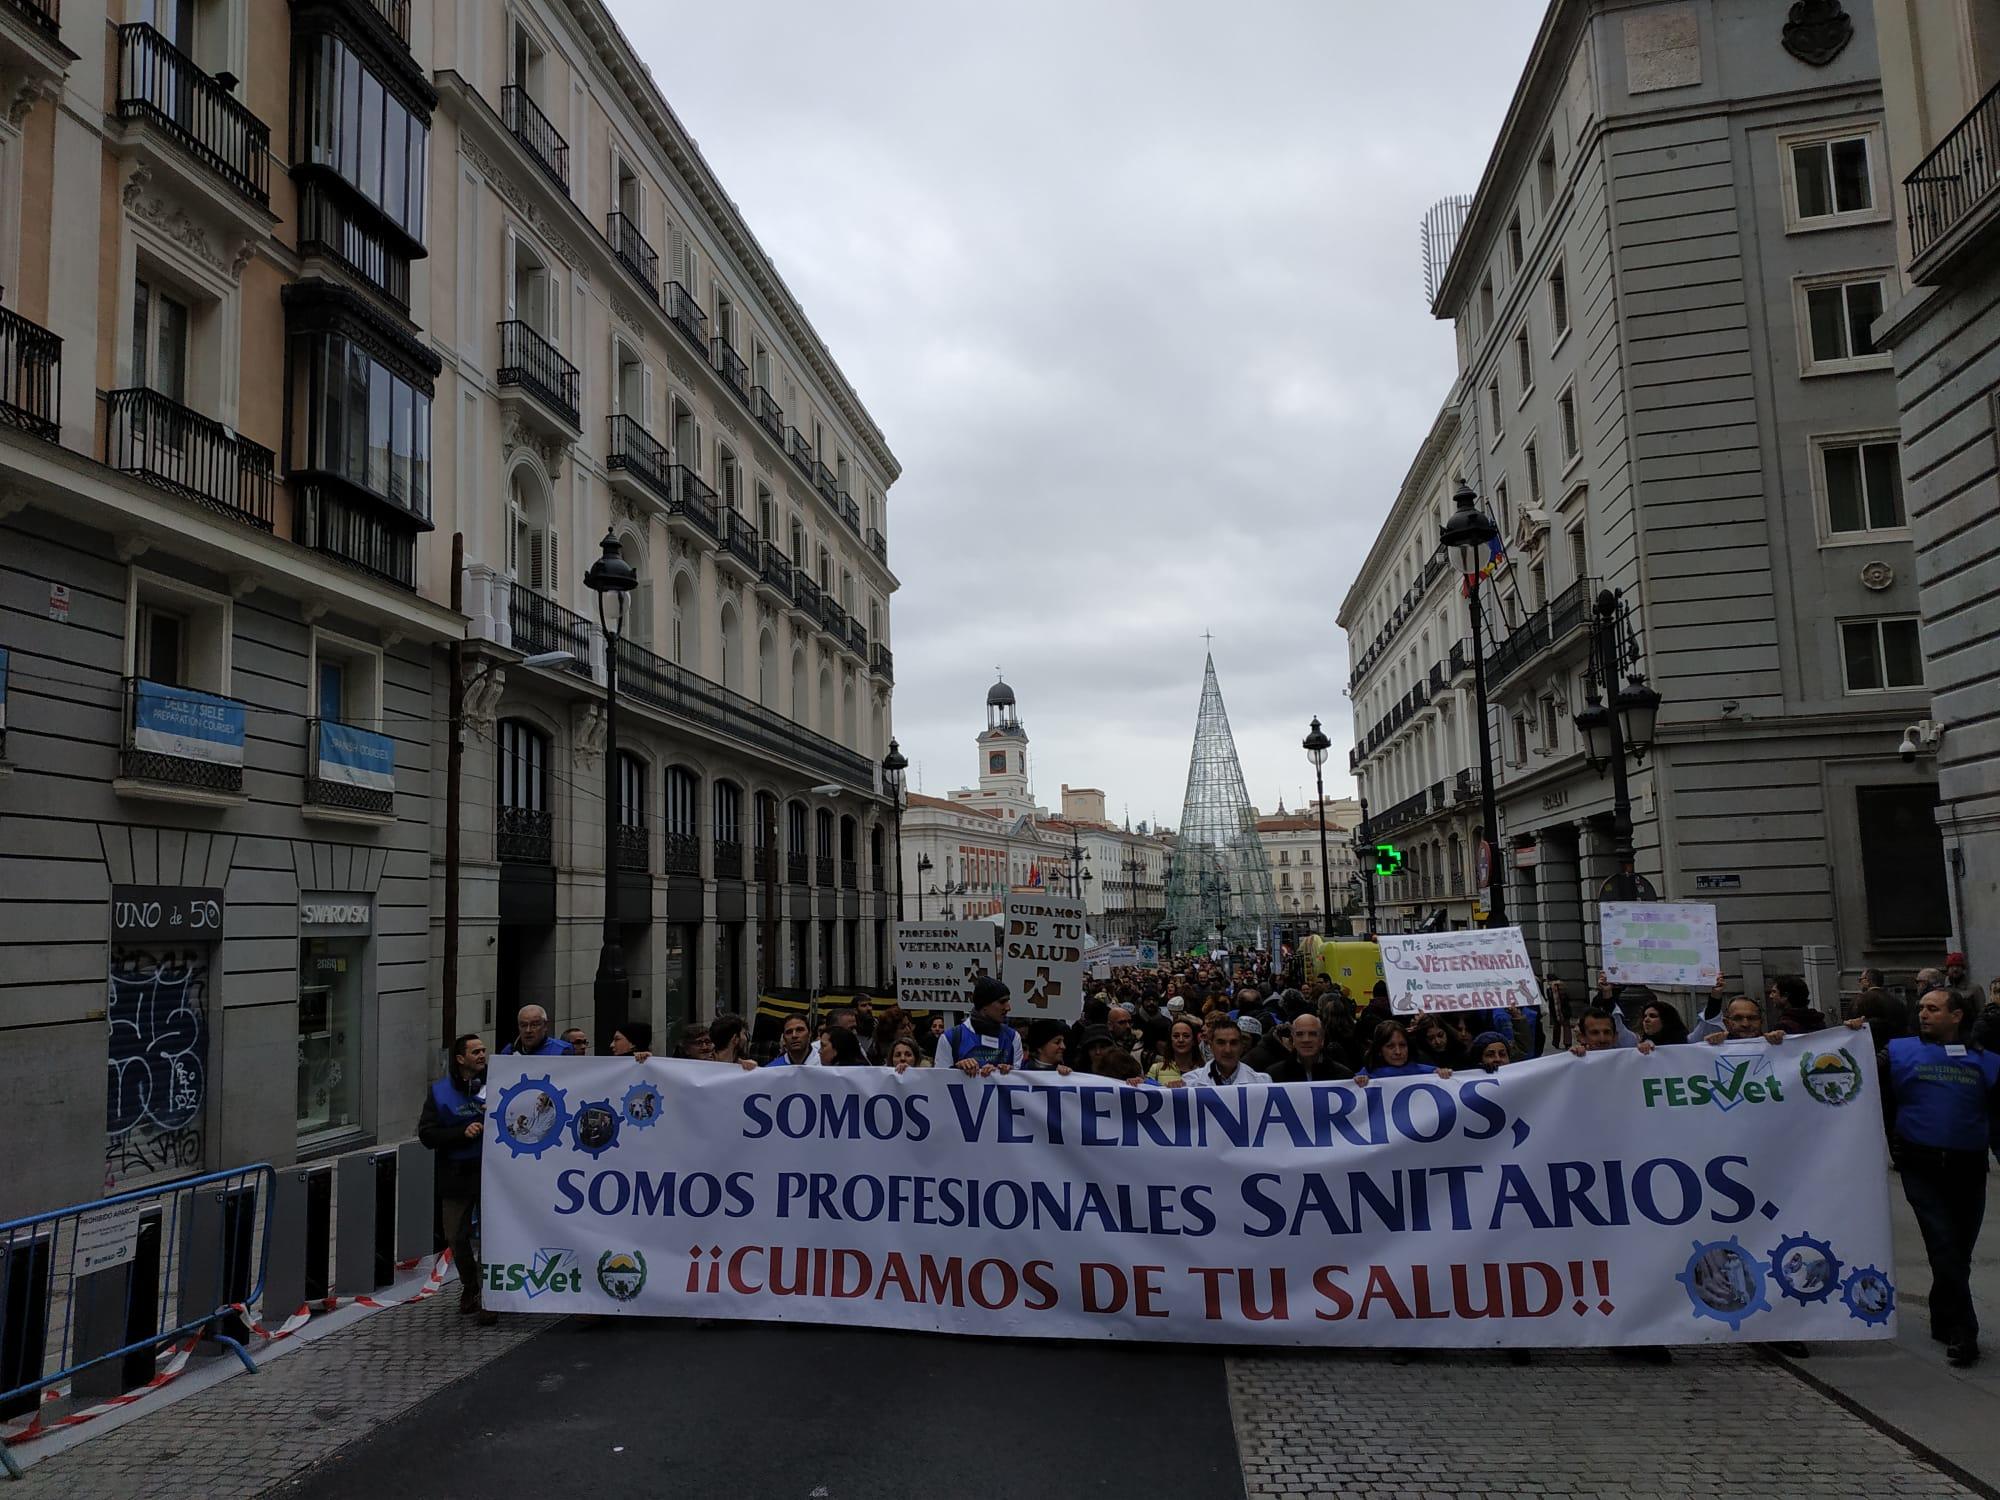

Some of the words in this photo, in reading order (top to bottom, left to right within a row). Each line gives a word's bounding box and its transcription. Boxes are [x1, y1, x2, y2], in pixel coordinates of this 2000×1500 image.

[153, 709, 200, 727] PREPARATION
[202, 720, 235, 734] COURSES
[115, 902, 161, 928] UNO
[169, 906, 183, 925] de
[190, 900, 220, 928] 50
[301, 905, 369, 924] SWAROVSKI
[1010, 904, 1082, 920] CUIDAMOS
[898, 926, 958, 939] PROFESIÓN
[1009, 920, 1039, 937] DE
[1053, 923, 1081, 940] TU
[898, 942, 993, 953] VETERINARIA
[1007, 942, 1081, 963] SALUD
[1402, 939, 1421, 952] Mi
[900, 976, 961, 987] PROFESIÓN
[1406, 978, 1424, 991] No
[901, 989, 973, 1003] SANITAR
[1643, 1060, 1785, 1108] FESVet
[742, 1093, 931, 1142] SOMOS
[946, 1078, 1531, 1149] VETERINARIOS,
[553, 1169, 755, 1218] SOMOS
[776, 1172, 1217, 1237] PROFESIONALES
[1240, 1156, 1780, 1237] SANITARIOS.
[685, 1244, 1059, 1313] ¡¡CUIDAMOS
[1079, 1262, 1170, 1318] DE
[1187, 1266, 1290, 1321] TU
[1312, 1259, 1616, 1321] SALUD!!
